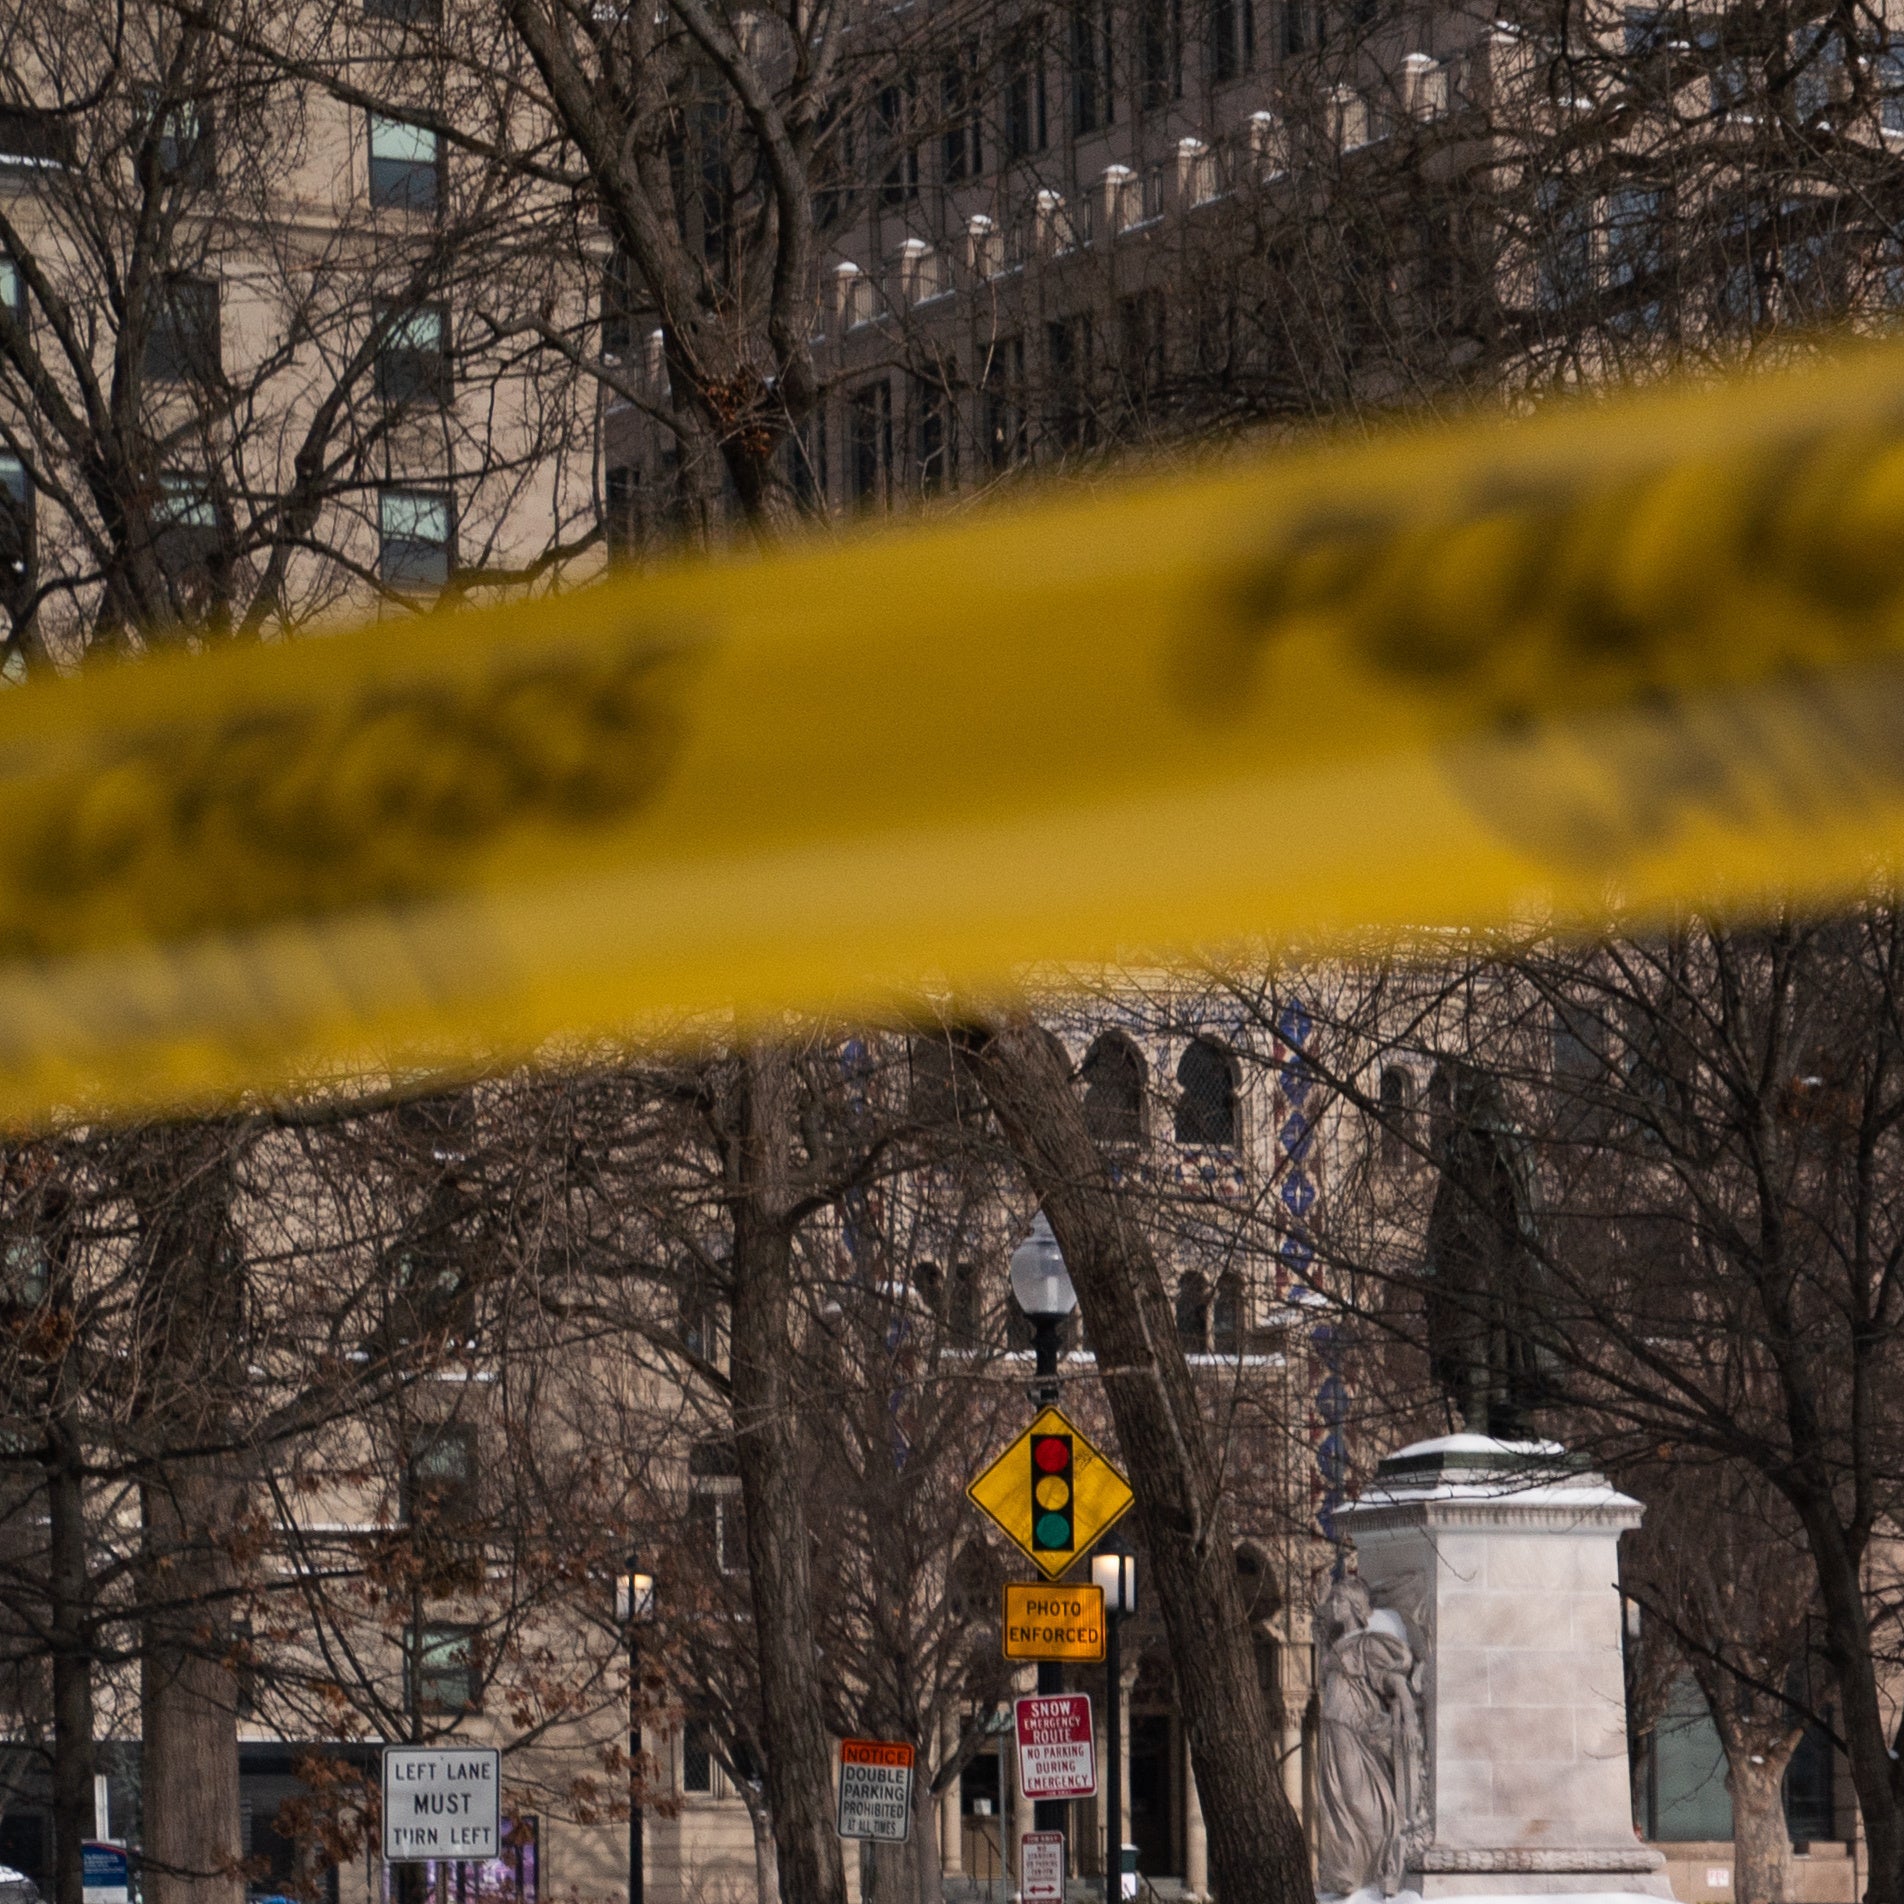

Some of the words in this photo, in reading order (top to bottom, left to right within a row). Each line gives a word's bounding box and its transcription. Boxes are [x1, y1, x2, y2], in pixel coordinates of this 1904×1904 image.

[1026, 1600, 1081, 1617] PHOTO
[1010, 1627, 1098, 1644] ENFORCED
[1031, 1701, 1071, 1718] SNOW
[1024, 1716, 1080, 1730] EMERGENCY
[1033, 1729, 1072, 1744] ROUTE
[847, 1747, 907, 1765] NOTICE
[1027, 1748, 1040, 1760] NO
[1044, 1744, 1084, 1758] PARKING
[395, 1763, 436, 1780] LEFT
[447, 1763, 491, 1780] LANE
[846, 1766, 904, 1784] DOUBLE
[1036, 1760, 1075, 1774] DURING
[1027, 1775, 1088, 1790] EMERGENCY
[844, 1783, 904, 1801] PARKING
[414, 1793, 471, 1814] MUST
[843, 1801, 904, 1819] PROHIBITED
[848, 1819, 856, 1831] AT
[874, 1821, 896, 1836] TIMES
[394, 1828, 438, 1845] TURN
[450, 1828, 491, 1844] LEFT
